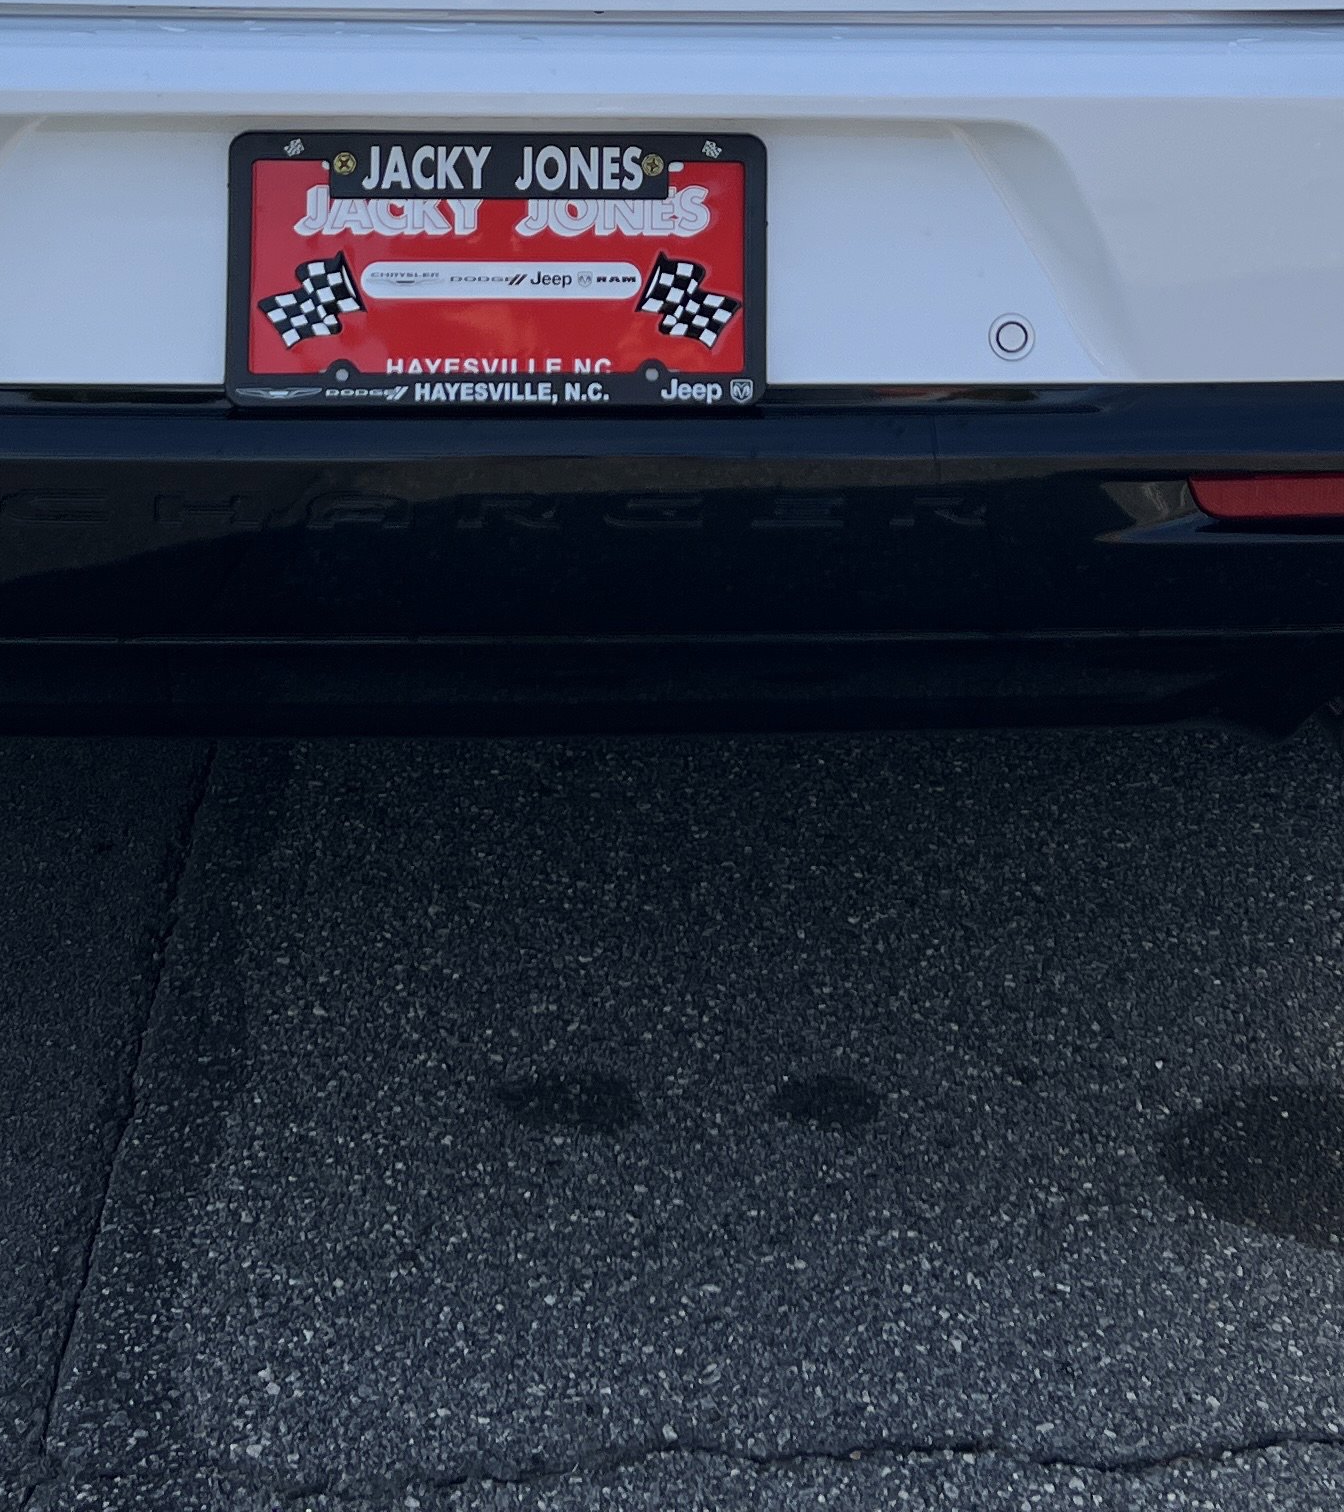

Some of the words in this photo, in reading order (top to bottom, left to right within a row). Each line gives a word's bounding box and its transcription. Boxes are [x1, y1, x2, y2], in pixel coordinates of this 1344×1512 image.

[361, 145, 493, 191] JACKY
[514, 145, 644, 191] JONES
[293, 184, 484, 236] JACKY
[515, 185, 710, 237] JONES
[529, 271, 572, 288] Jeep
[414, 382, 559, 404] HAYESVILLE,
[564, 382, 610, 401] N.C.
[660, 378, 723, 404] Jeep
